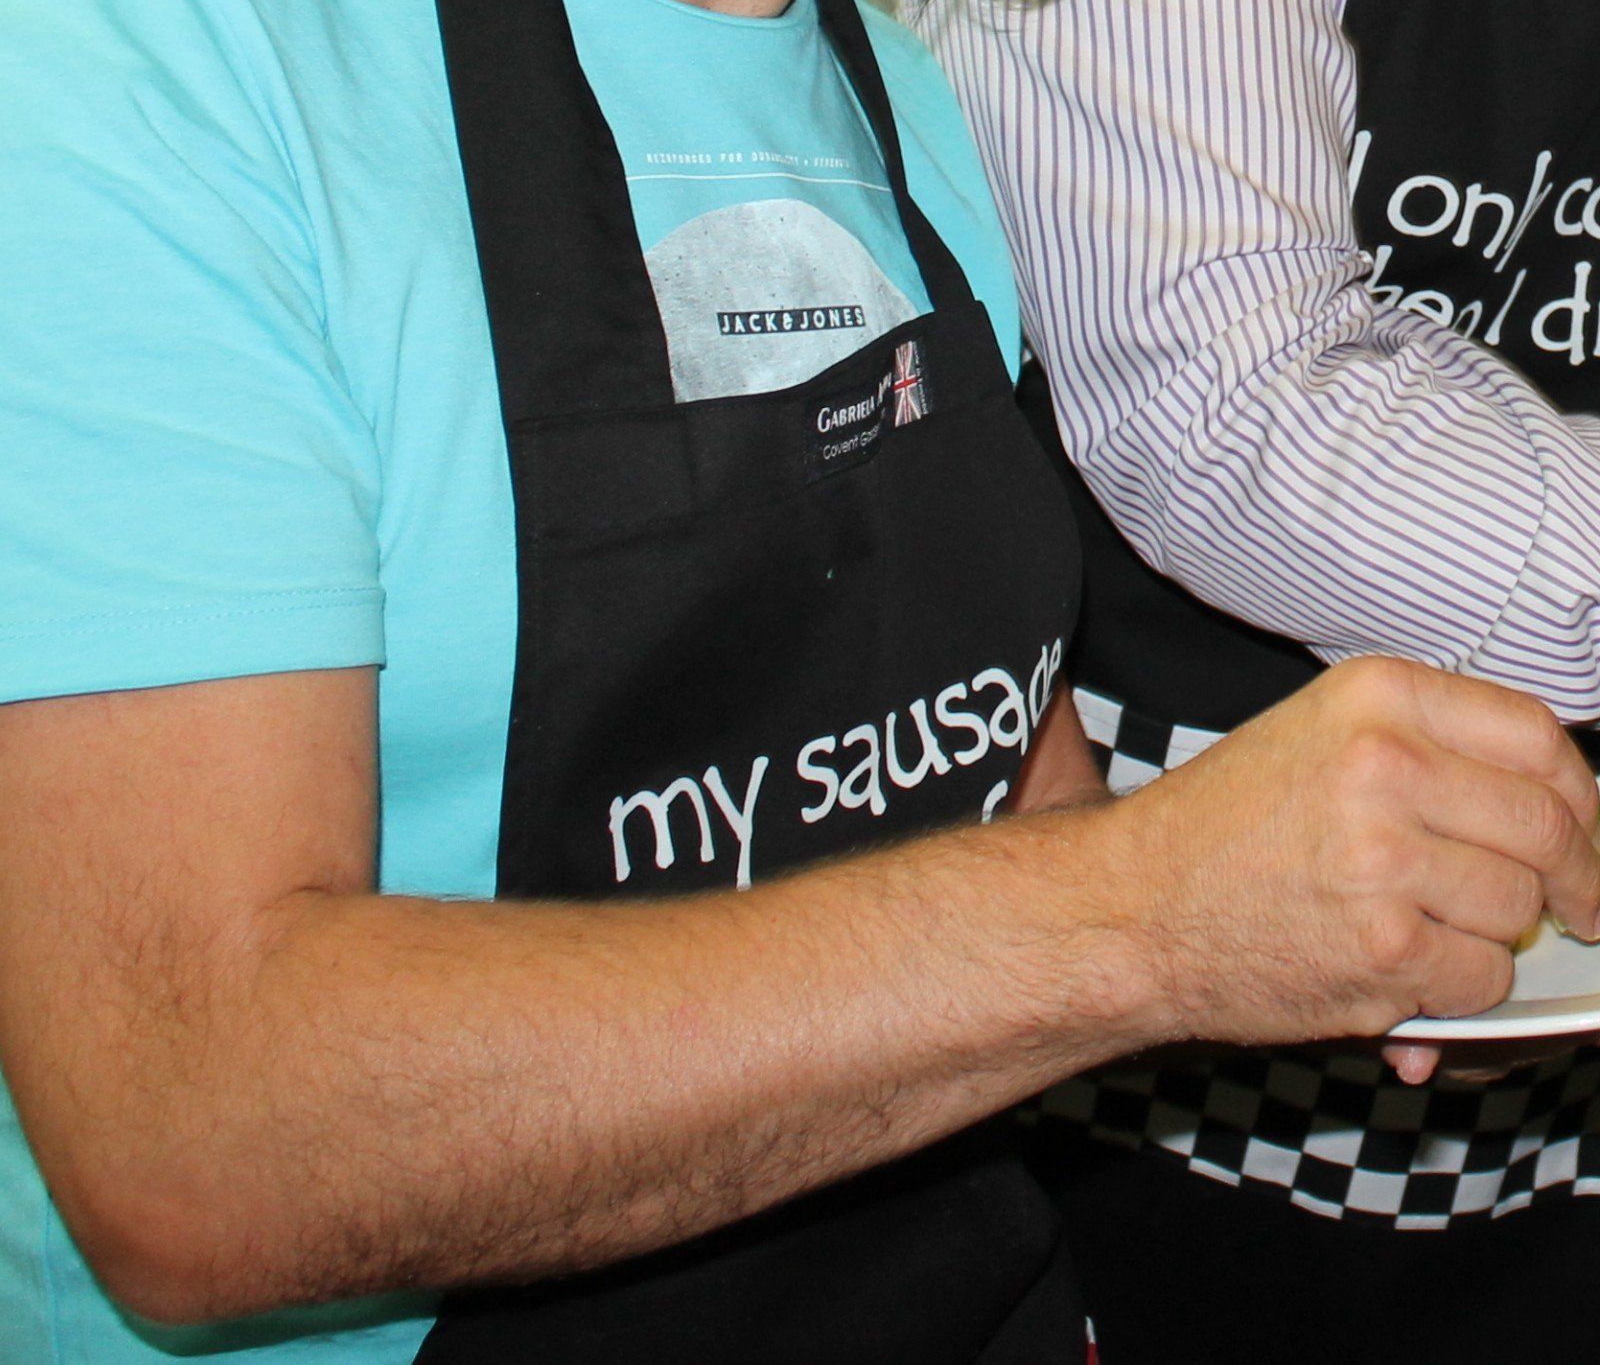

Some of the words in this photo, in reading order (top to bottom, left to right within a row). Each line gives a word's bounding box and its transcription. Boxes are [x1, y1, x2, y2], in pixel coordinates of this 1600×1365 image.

[720, 152, 744, 164] FOR
[1387, 150, 1553, 273] only
[817, 396, 875, 433] GABRIELA
[823, 434, 859, 460] Covent
[609, 756, 769, 891] my
